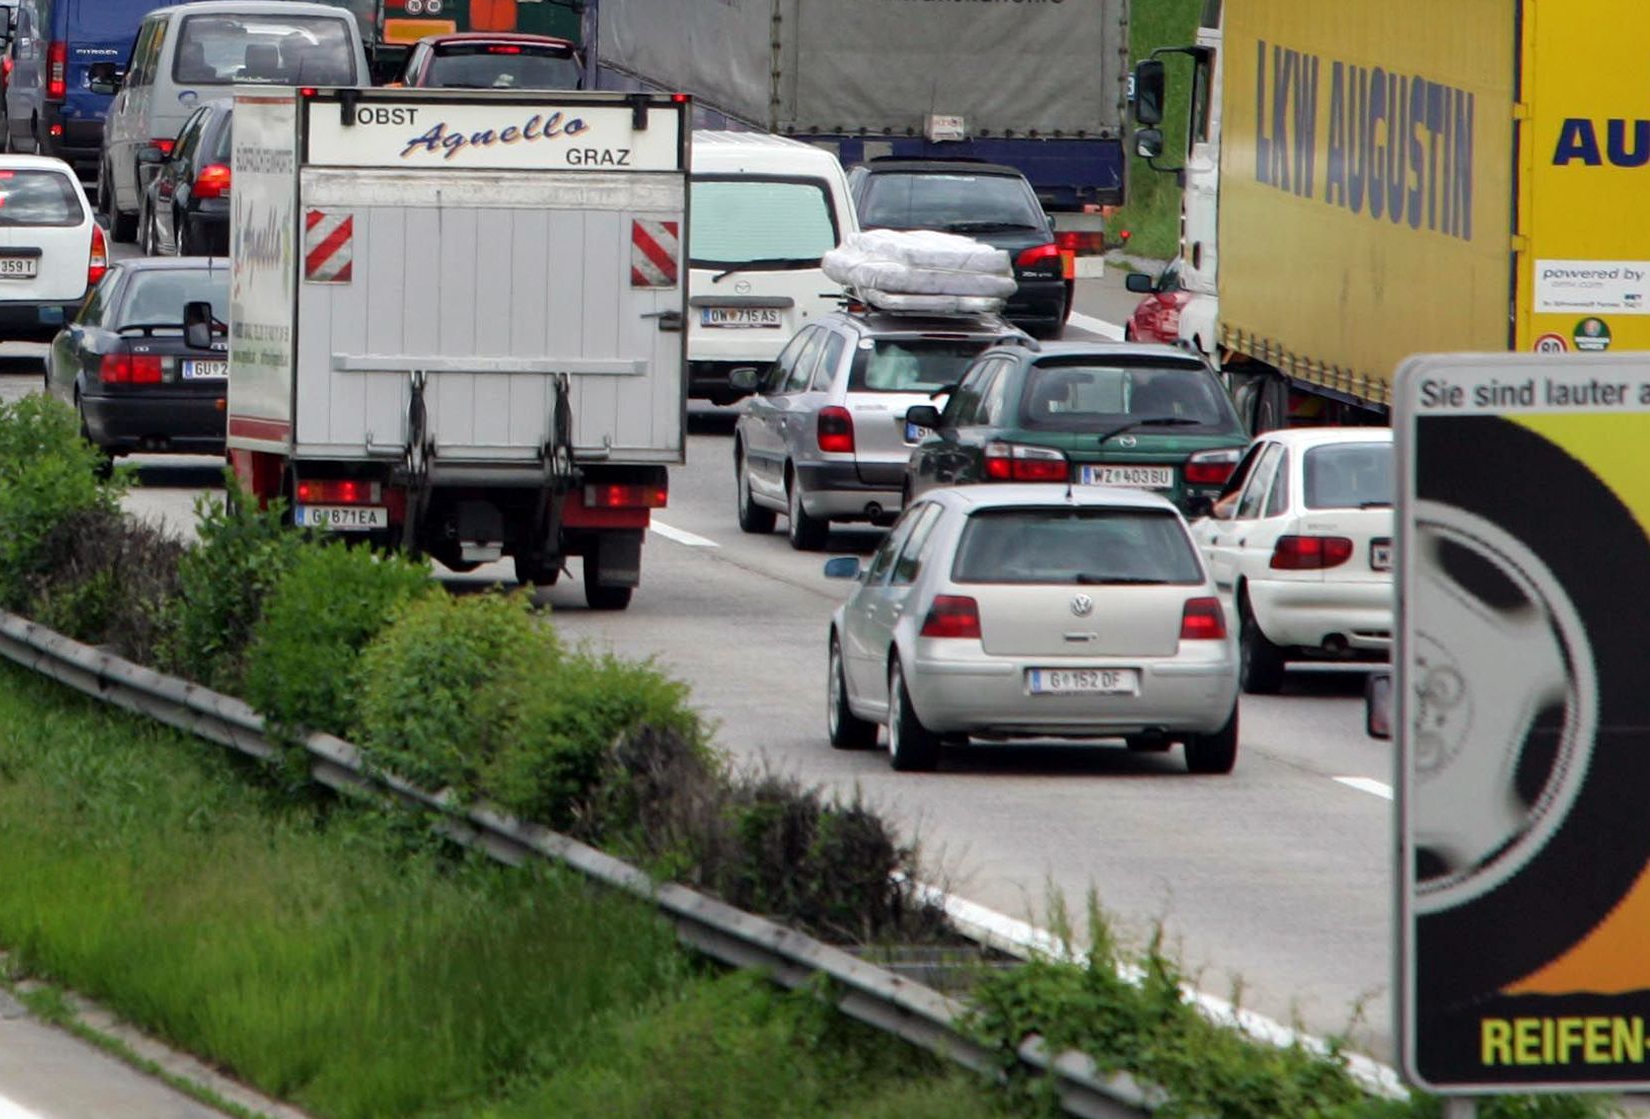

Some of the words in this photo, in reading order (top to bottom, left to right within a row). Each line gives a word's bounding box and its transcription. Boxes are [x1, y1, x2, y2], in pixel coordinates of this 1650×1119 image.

[357, 107, 418, 126] OBST
[399, 110, 591, 159] Agnello
[1256, 39, 1320, 200] LKW
[1325, 60, 1476, 242] AUGUSTIN
[566, 148, 631, 166] GRAZ
[1543, 267, 1619, 281] powered
[1623, 267, 1646, 282] by
[194, 362, 211, 376] GU
[1420, 379, 1464, 407] Sie
[1474, 379, 1535, 407] sind
[1545, 378, 1629, 407] lauter
